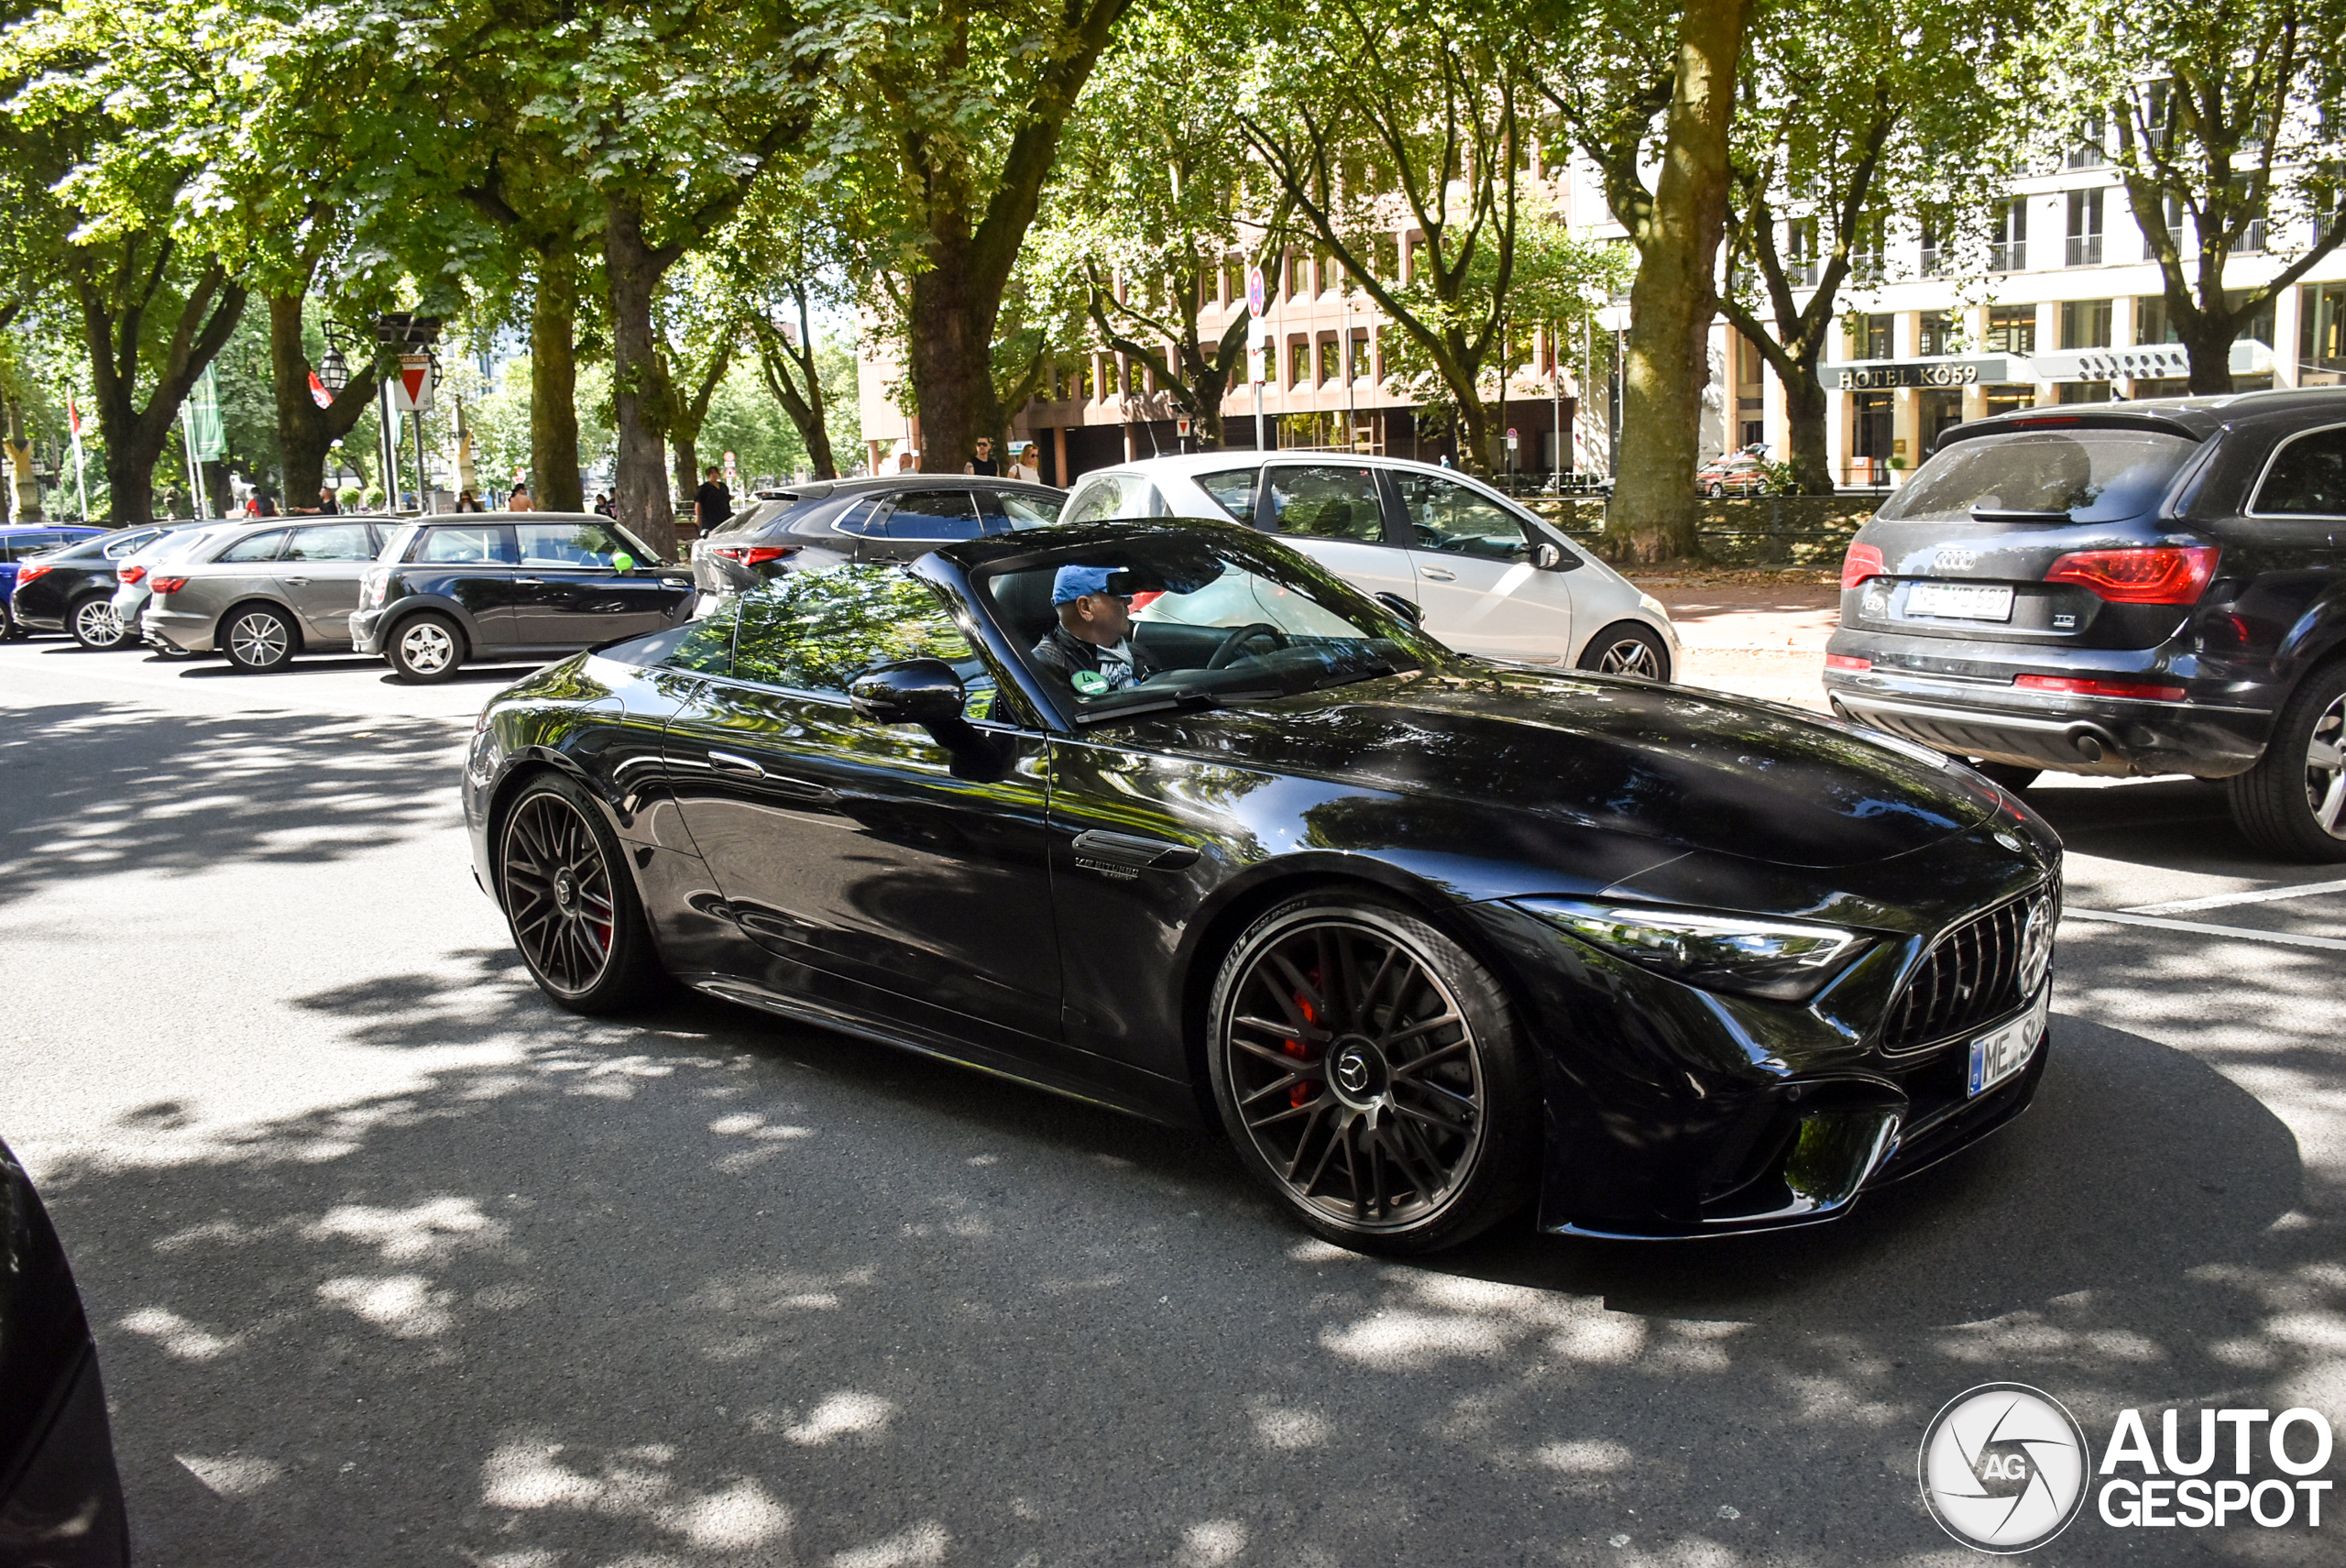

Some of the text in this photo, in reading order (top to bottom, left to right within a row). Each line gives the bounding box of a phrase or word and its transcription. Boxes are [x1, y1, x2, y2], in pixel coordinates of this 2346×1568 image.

[1837, 364, 1978, 389] HOTEL KÖ59
[2055, 614, 2076, 623] TDI
[1081, 672, 1094, 683] 4
[1075, 857, 1139, 876] V8 BITURBO
[1250, 916, 1270, 936] PILOT
[1271, 903, 1296, 920] SPORT
[1972, 1073, 1978, 1085] D
[1983, 1031, 2011, 1083] ME
